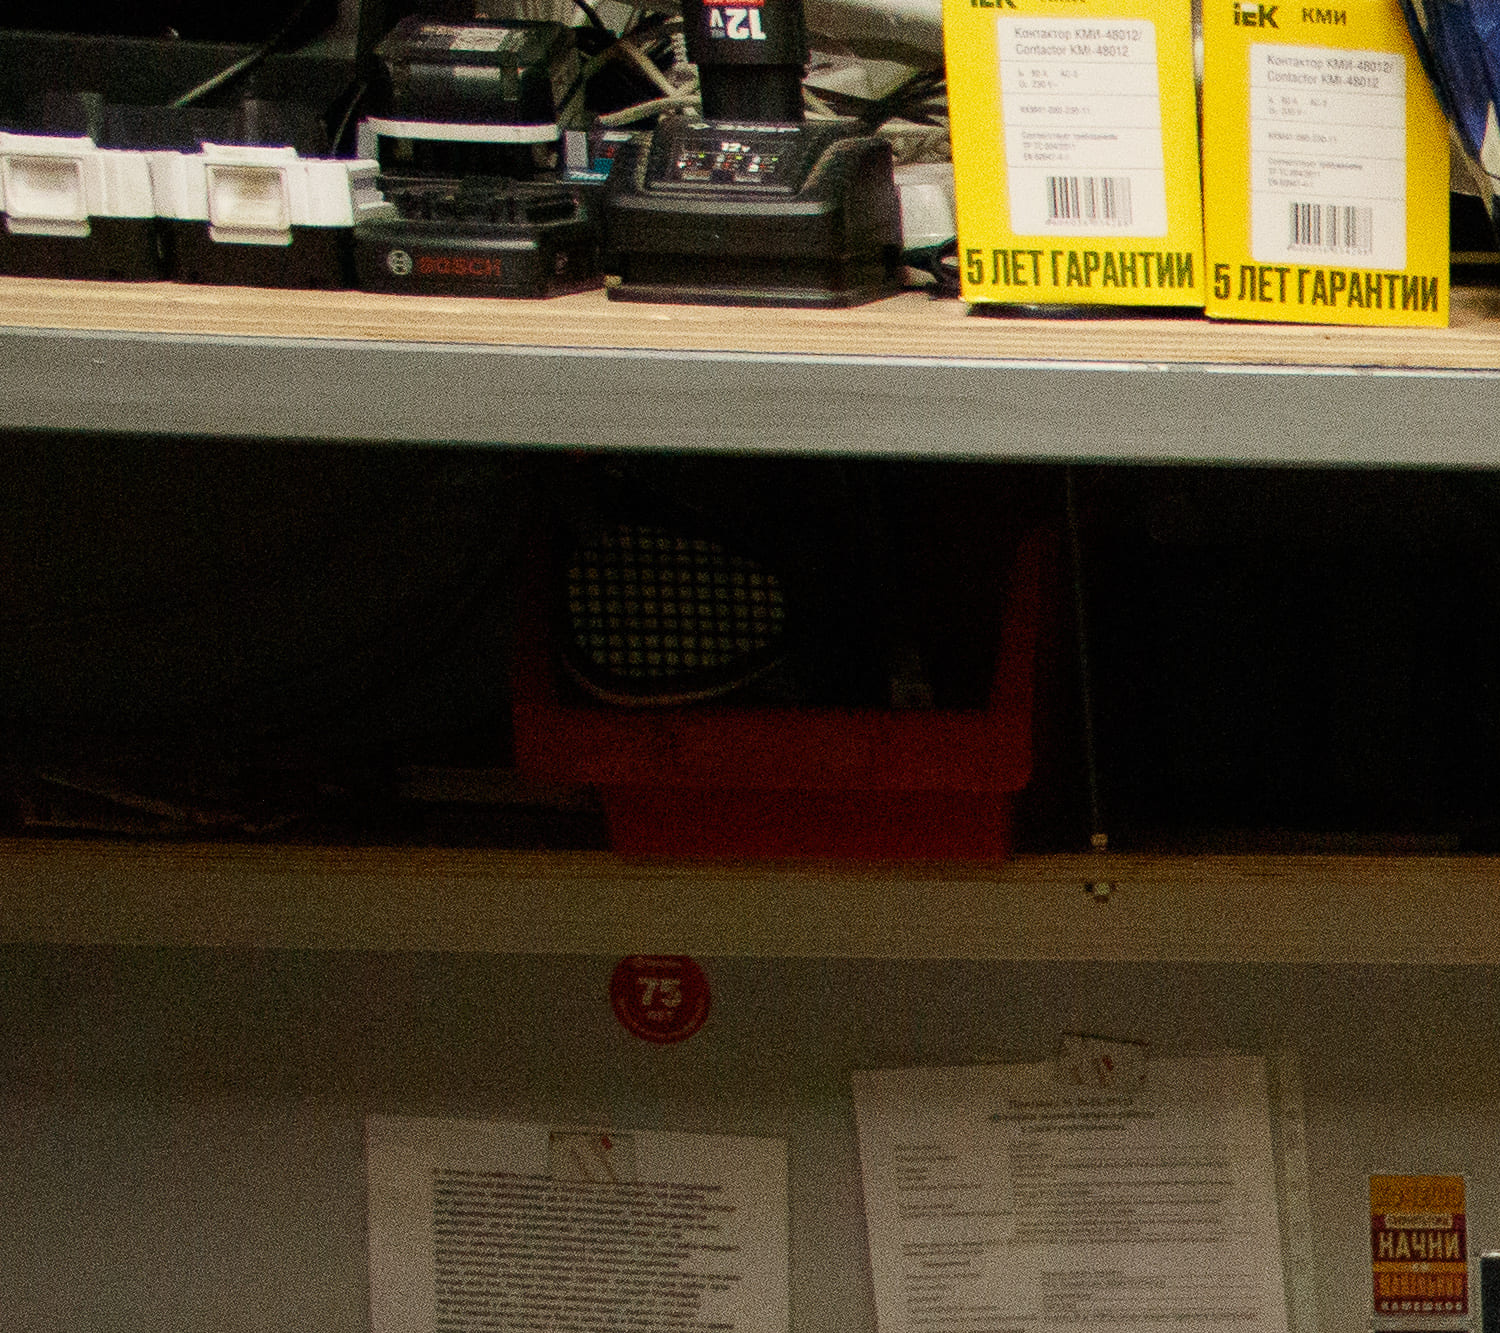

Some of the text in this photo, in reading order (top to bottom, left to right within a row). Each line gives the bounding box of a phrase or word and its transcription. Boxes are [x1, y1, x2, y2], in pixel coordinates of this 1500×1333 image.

[1302, 7, 1347, 25] КМИ
[1014, 28, 1069, 41] Контактор
[1015, 44, 1067, 56] Contactor
[418, 256, 502, 277] BOSCH
[966, 248, 1195, 289] 5 ЛЕТ ГАРАНТИИ
[1213, 263, 1439, 312] 5 ЛЕТ ГАРАНТИИ
[635, 975, 683, 1008] 75
[1378, 1231, 1460, 1260] НАЧНИ
